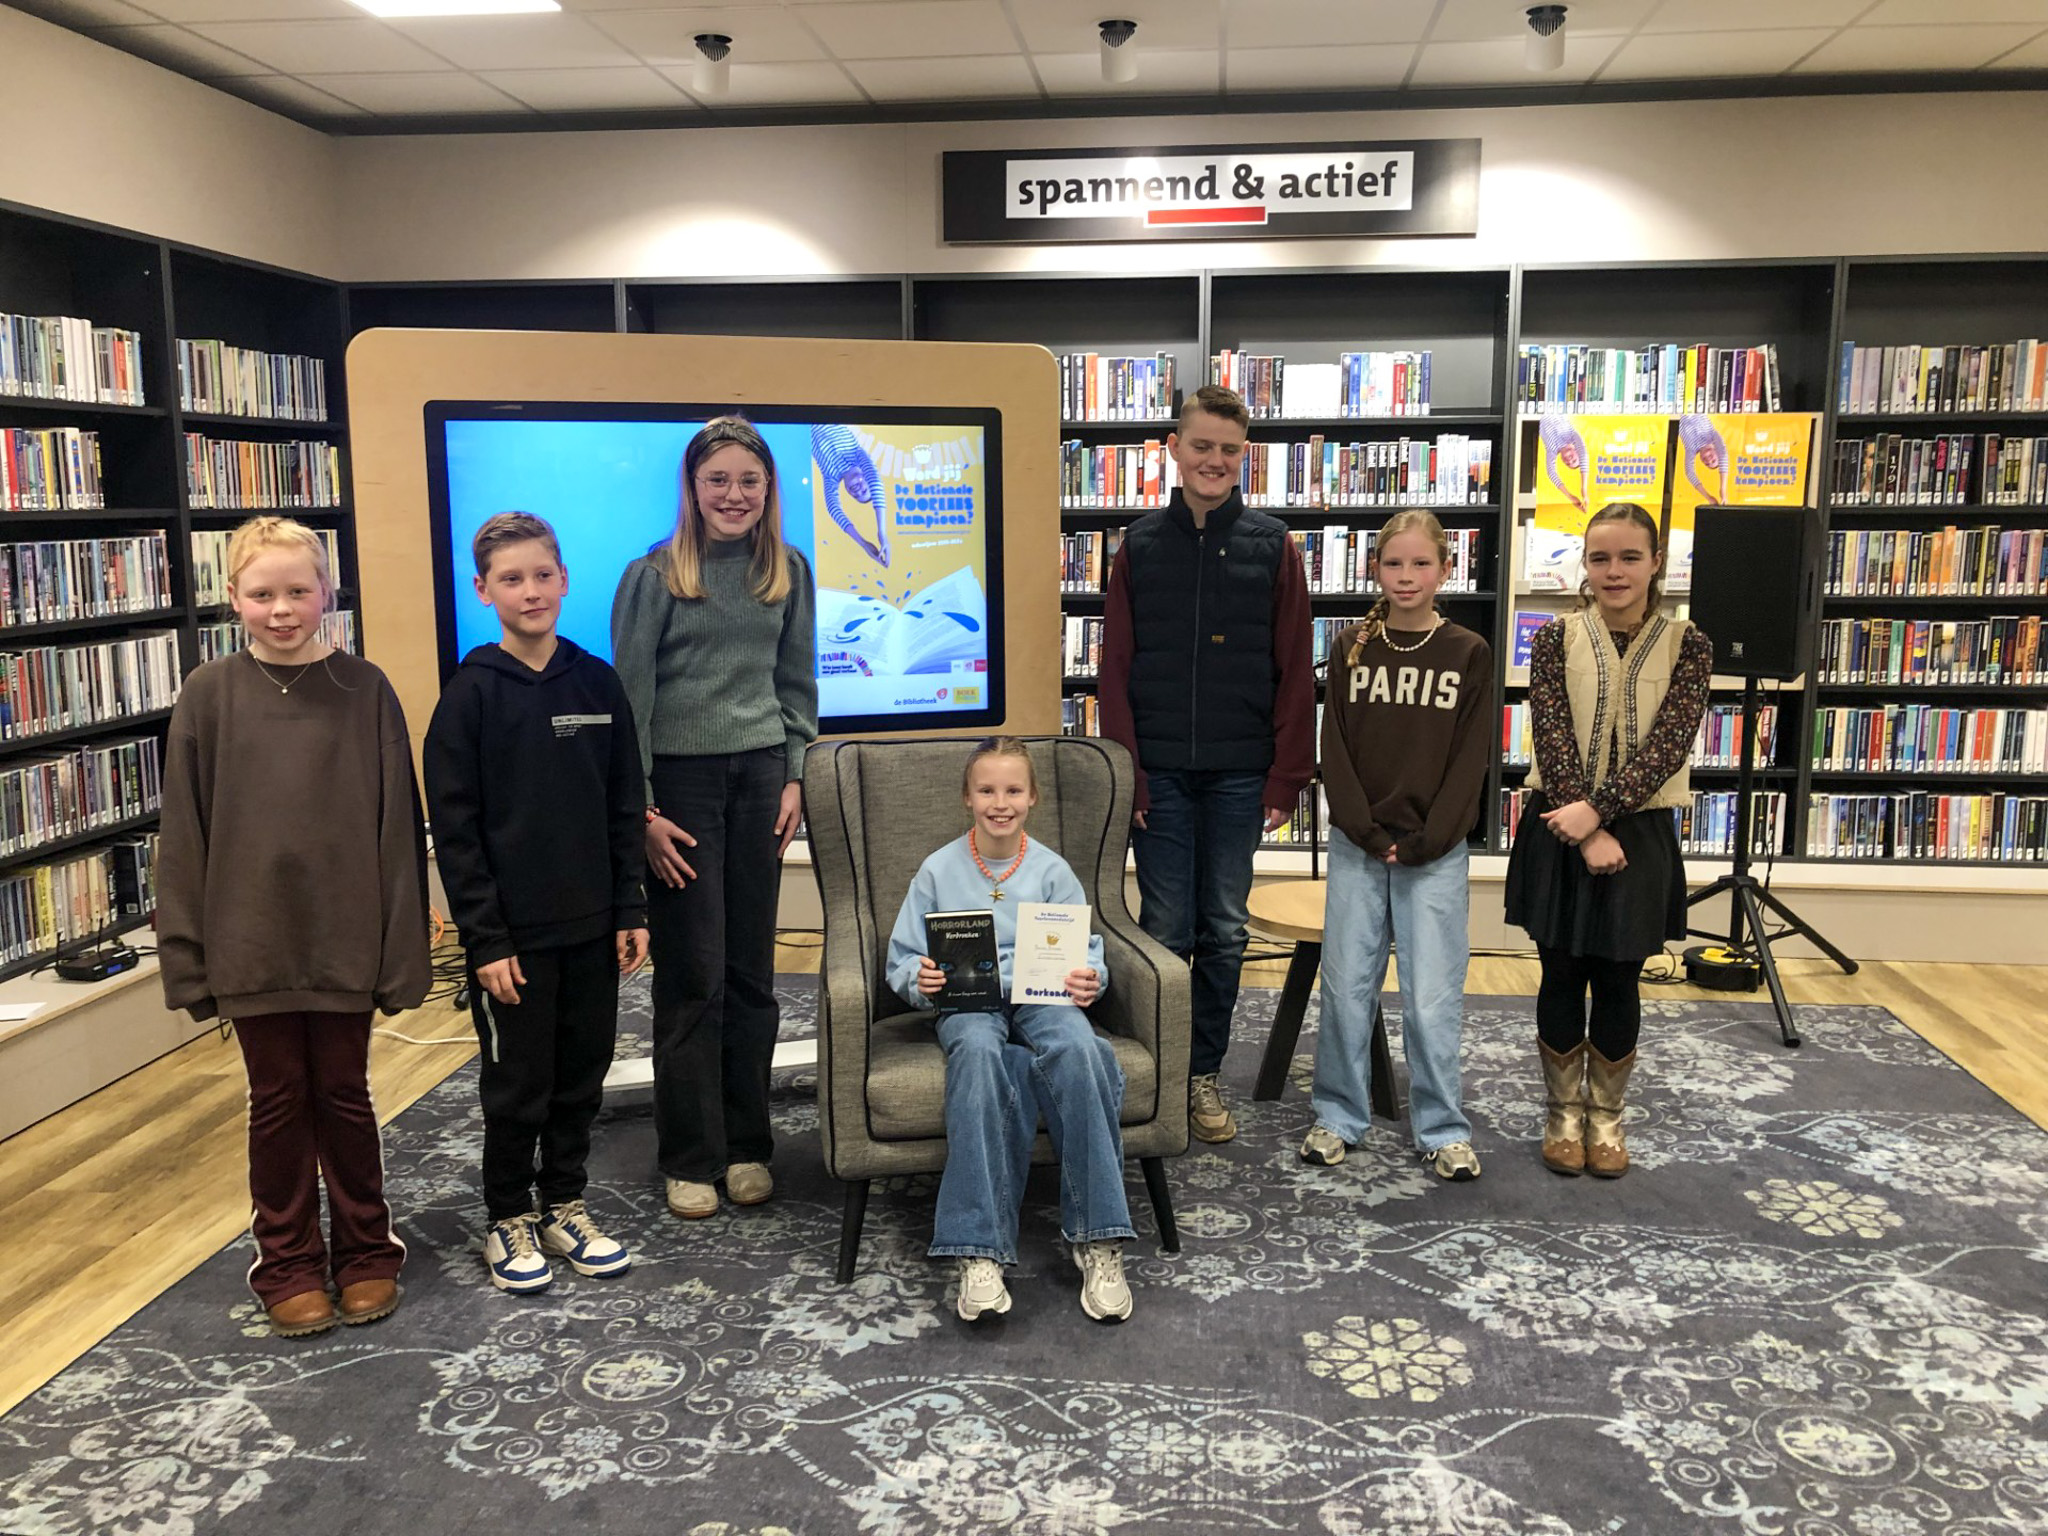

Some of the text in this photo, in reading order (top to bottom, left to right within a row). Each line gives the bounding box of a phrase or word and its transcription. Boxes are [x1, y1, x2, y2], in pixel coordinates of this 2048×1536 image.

[1018, 160, 1399, 216] spannend & actief
[1612, 455, 1656, 463] Nationale
[903, 465, 941, 482] Word
[895, 483, 974, 495] De Nationale
[896, 497, 974, 511] VOORLEES
[895, 511, 974, 529] kampioen?
[1349, 666, 1461, 710] PARIS
[930, 919, 991, 932] HORRORLAND
